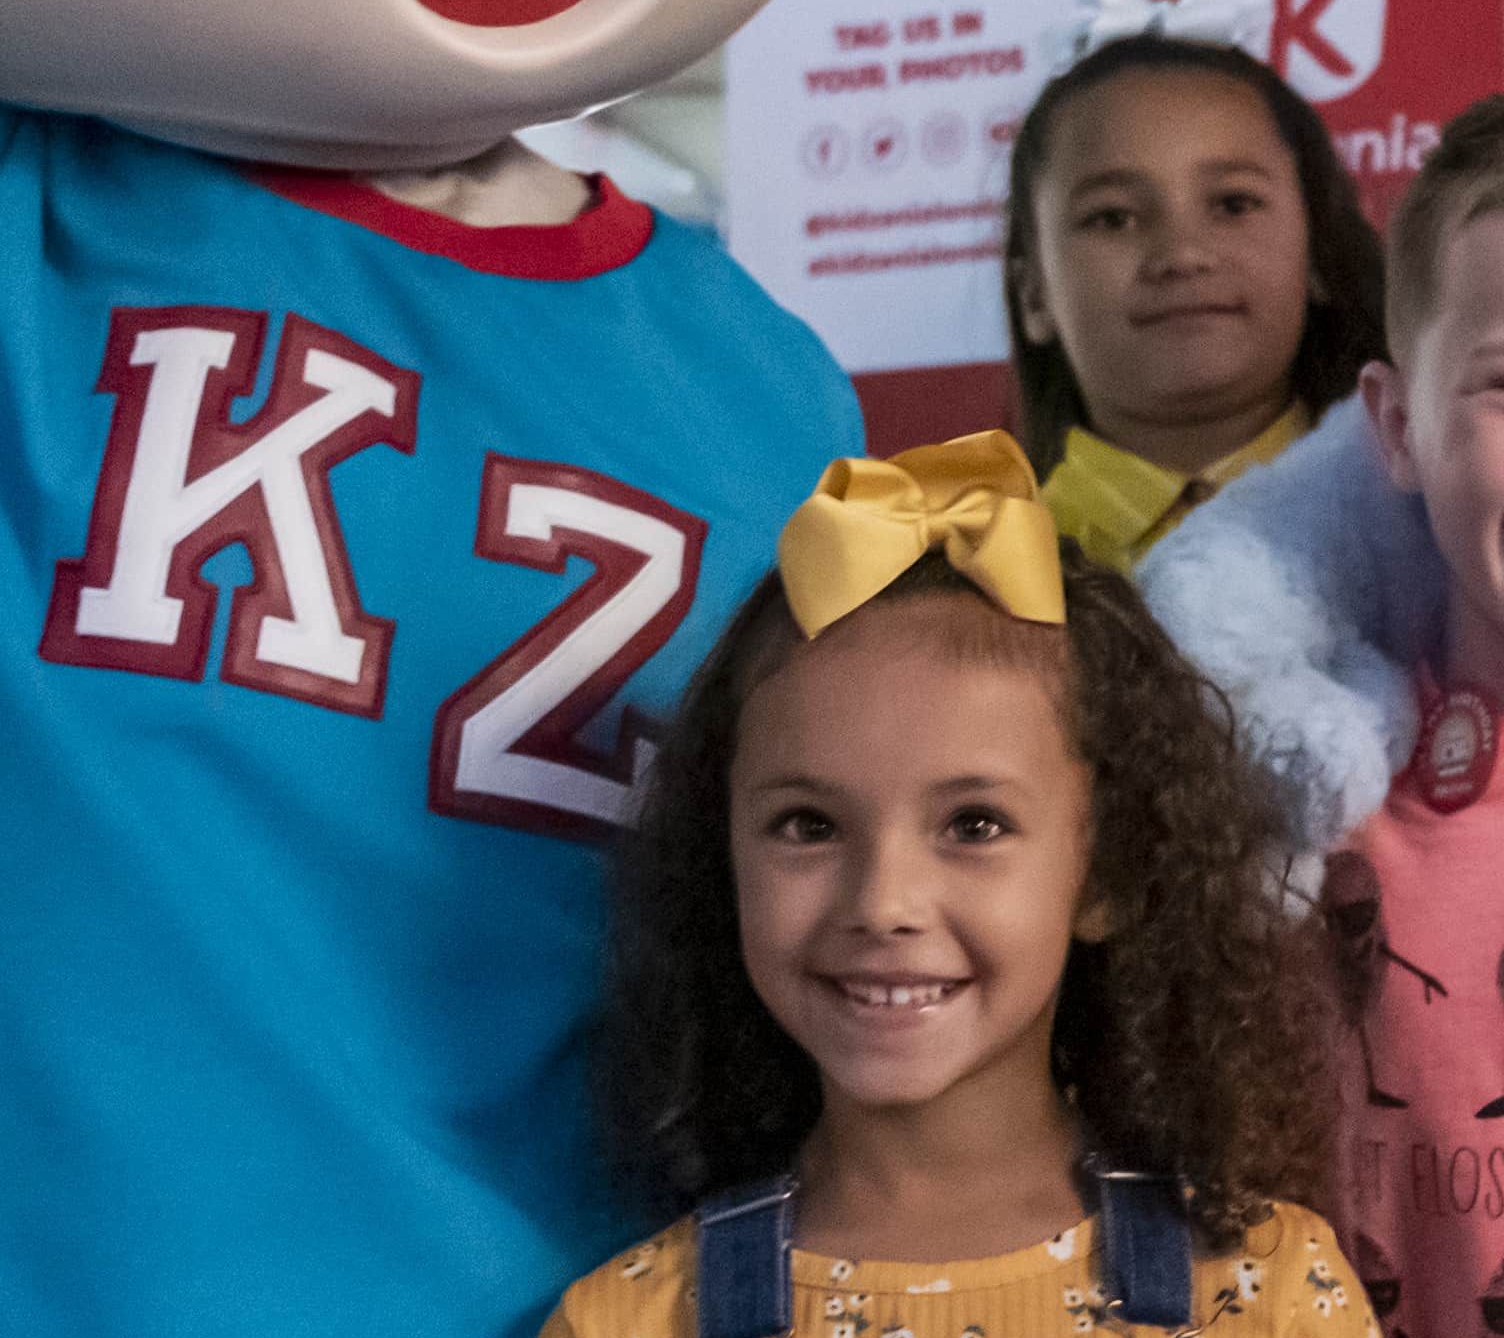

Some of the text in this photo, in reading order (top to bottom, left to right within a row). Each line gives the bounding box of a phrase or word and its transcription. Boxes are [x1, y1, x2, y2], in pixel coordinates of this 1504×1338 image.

[835, 11, 983, 51] TAG US IN
[806, 48, 1024, 93] YOUR PHOTOS
